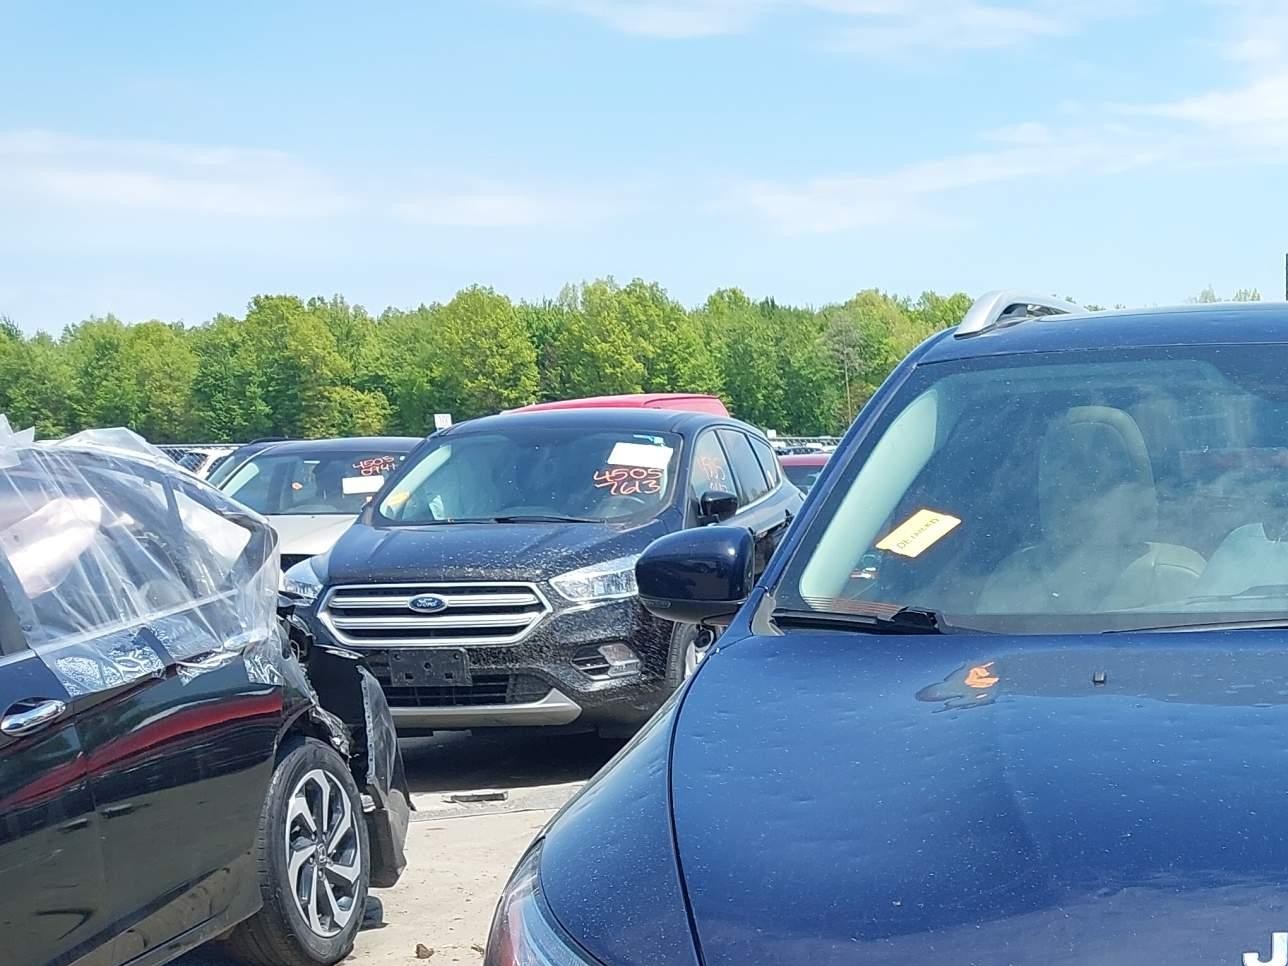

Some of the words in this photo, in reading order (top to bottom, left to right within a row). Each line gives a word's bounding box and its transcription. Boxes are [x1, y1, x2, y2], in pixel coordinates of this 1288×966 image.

[352, 455, 395, 469] 4505
[593, 468, 663, 482] 4505
[594, 479, 661, 495] 7613
